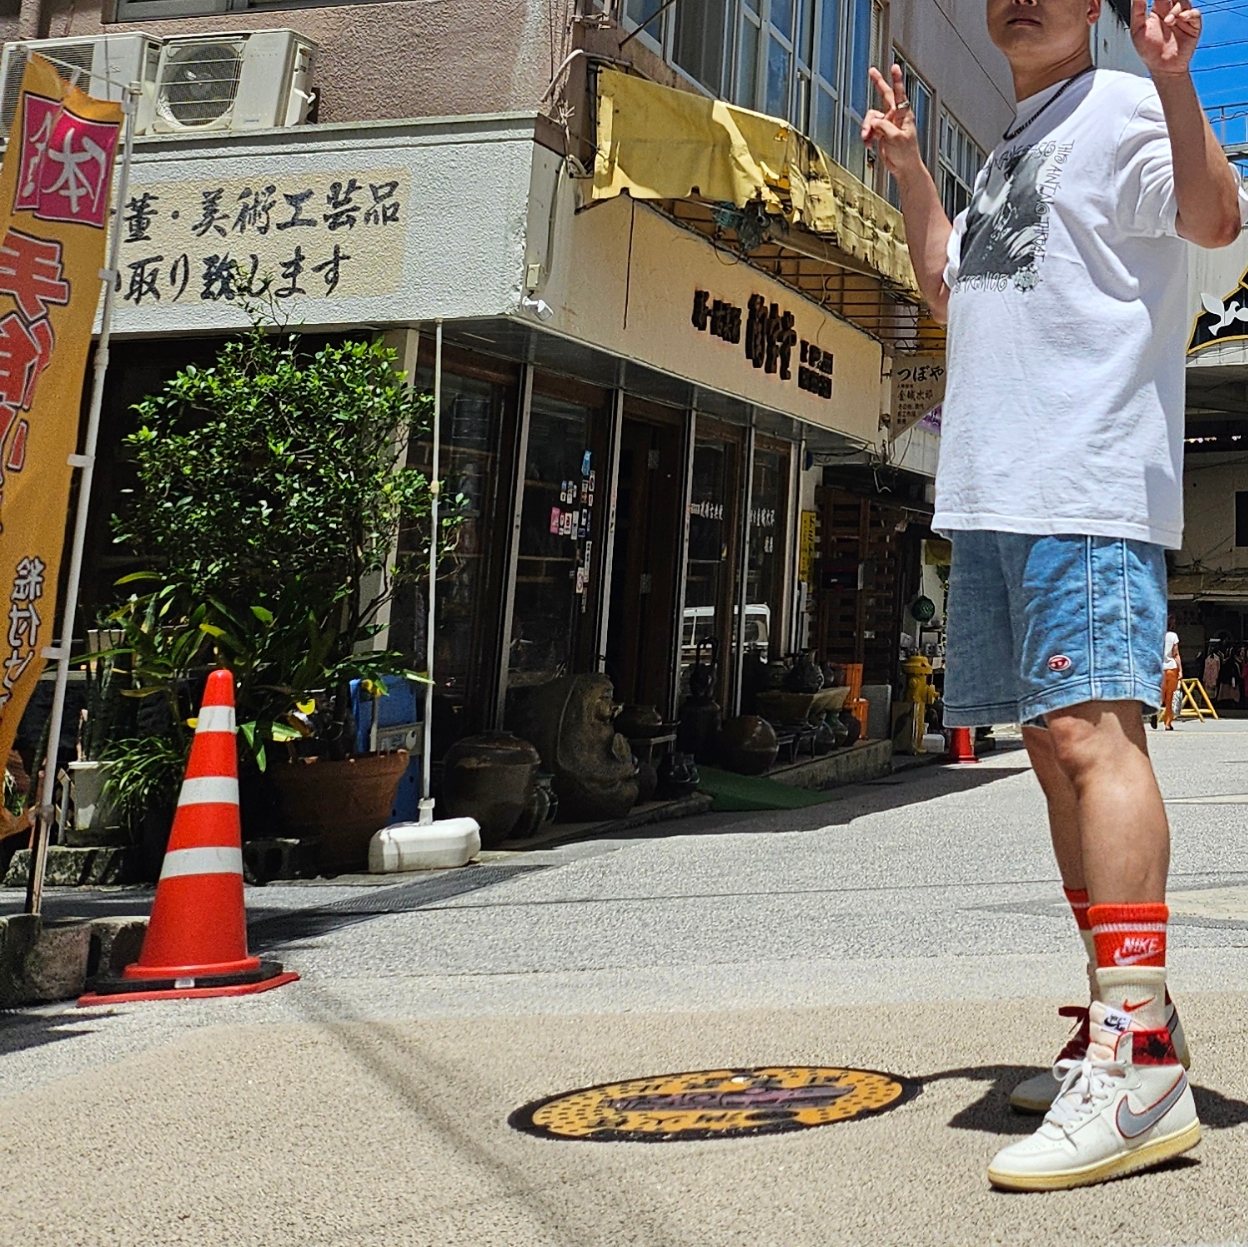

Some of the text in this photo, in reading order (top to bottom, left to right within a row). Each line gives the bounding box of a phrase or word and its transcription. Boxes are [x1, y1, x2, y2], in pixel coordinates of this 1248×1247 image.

[110, 179, 400, 244] 董・美術工芸品
[897, 365, 944, 382] つぼや
[1122, 937, 1159, 952] NIKE
